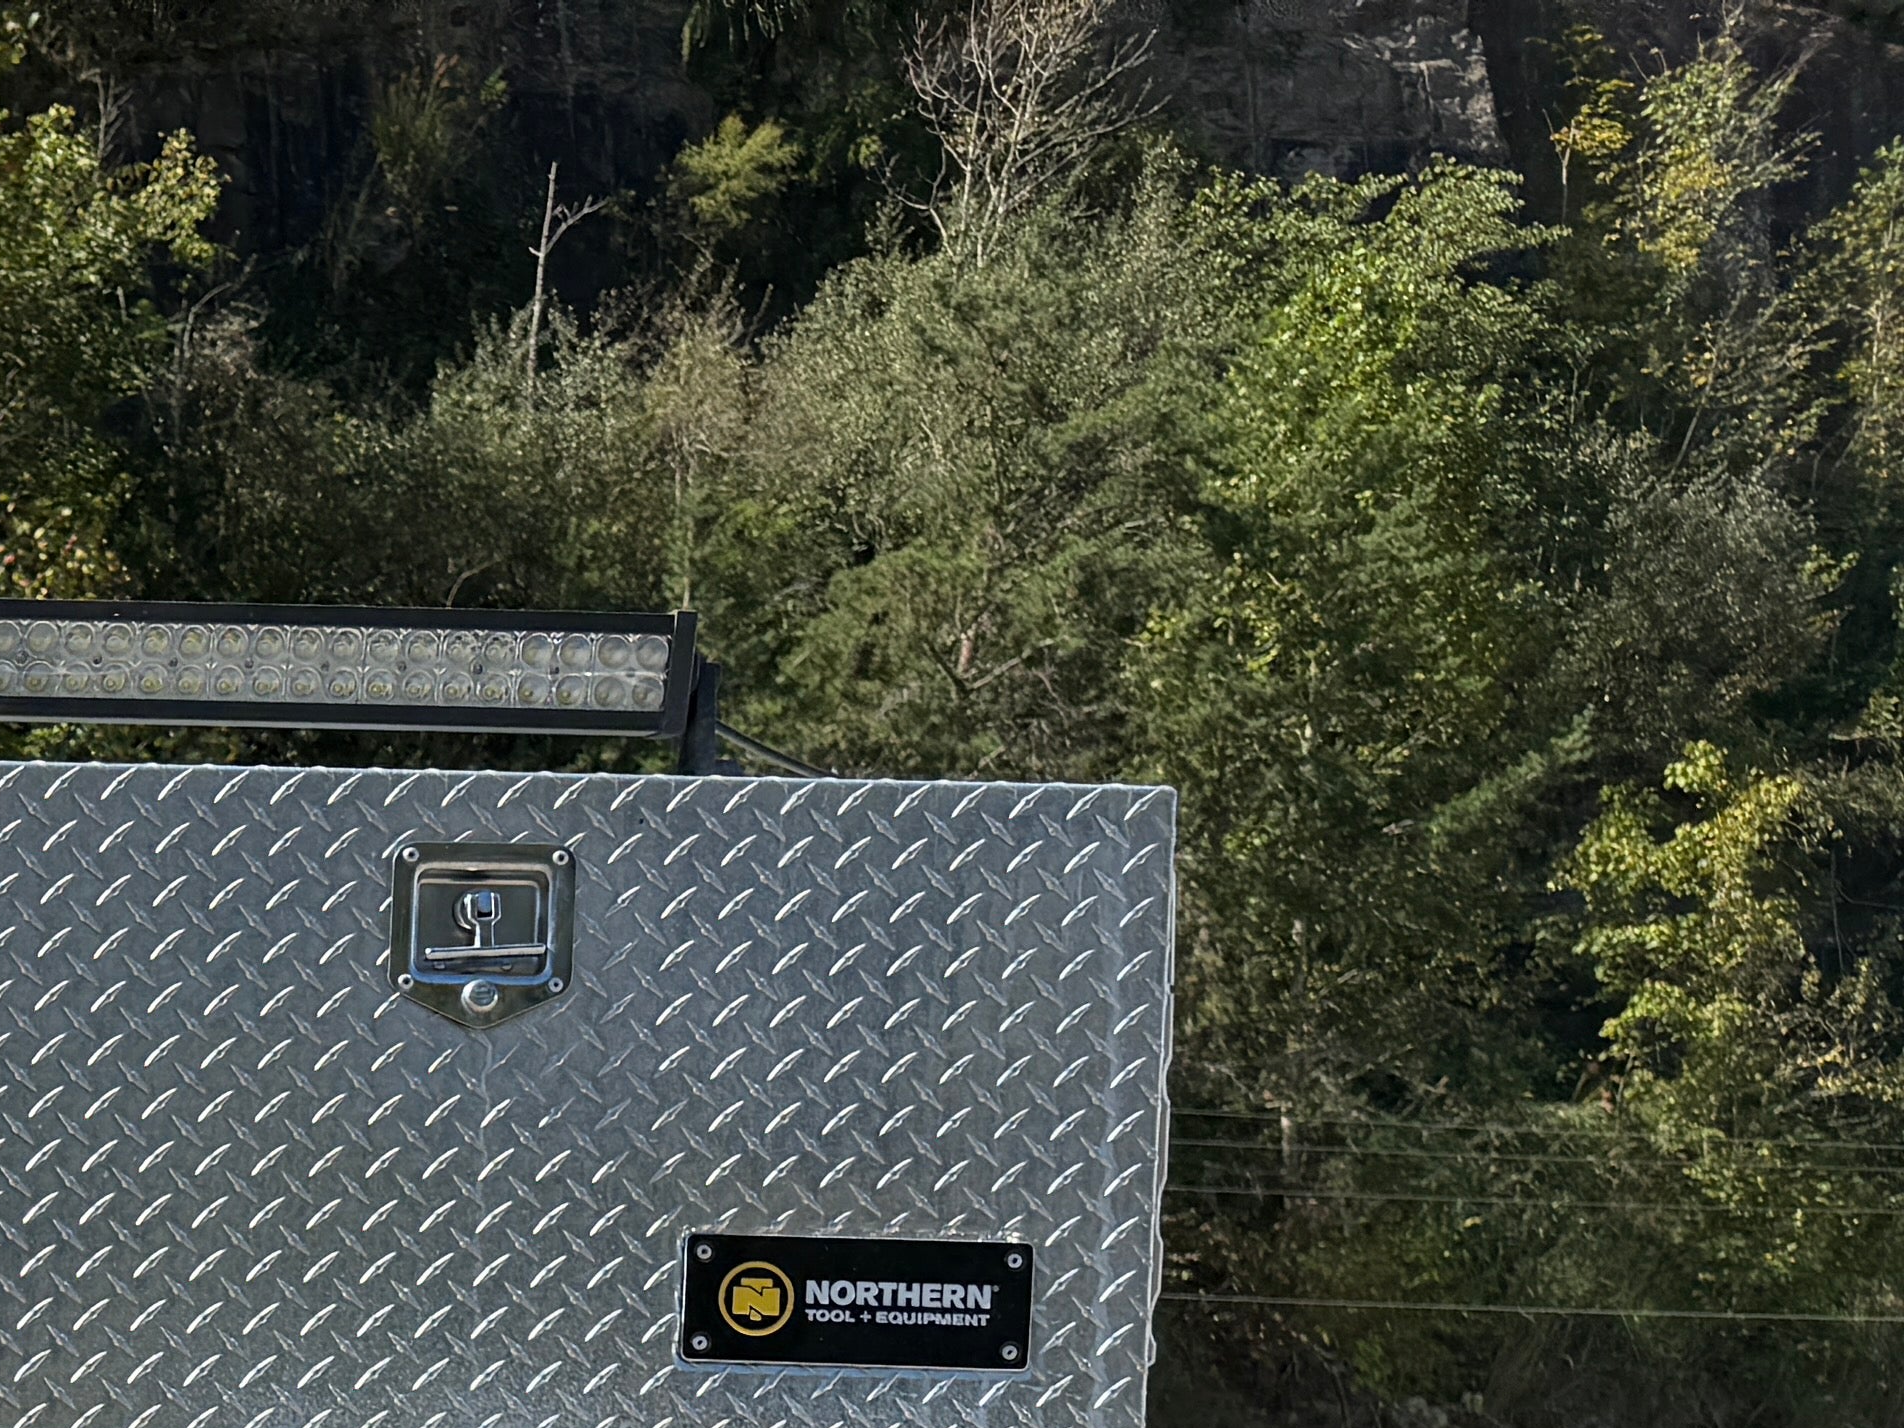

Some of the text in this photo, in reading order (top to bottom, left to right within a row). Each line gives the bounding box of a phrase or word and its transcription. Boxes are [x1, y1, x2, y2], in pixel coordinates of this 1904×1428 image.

[804, 1279, 992, 1310] NORTHERN
[805, 1309, 856, 1324] TOOL
[875, 1310, 990, 1327] EQUIPMENT
